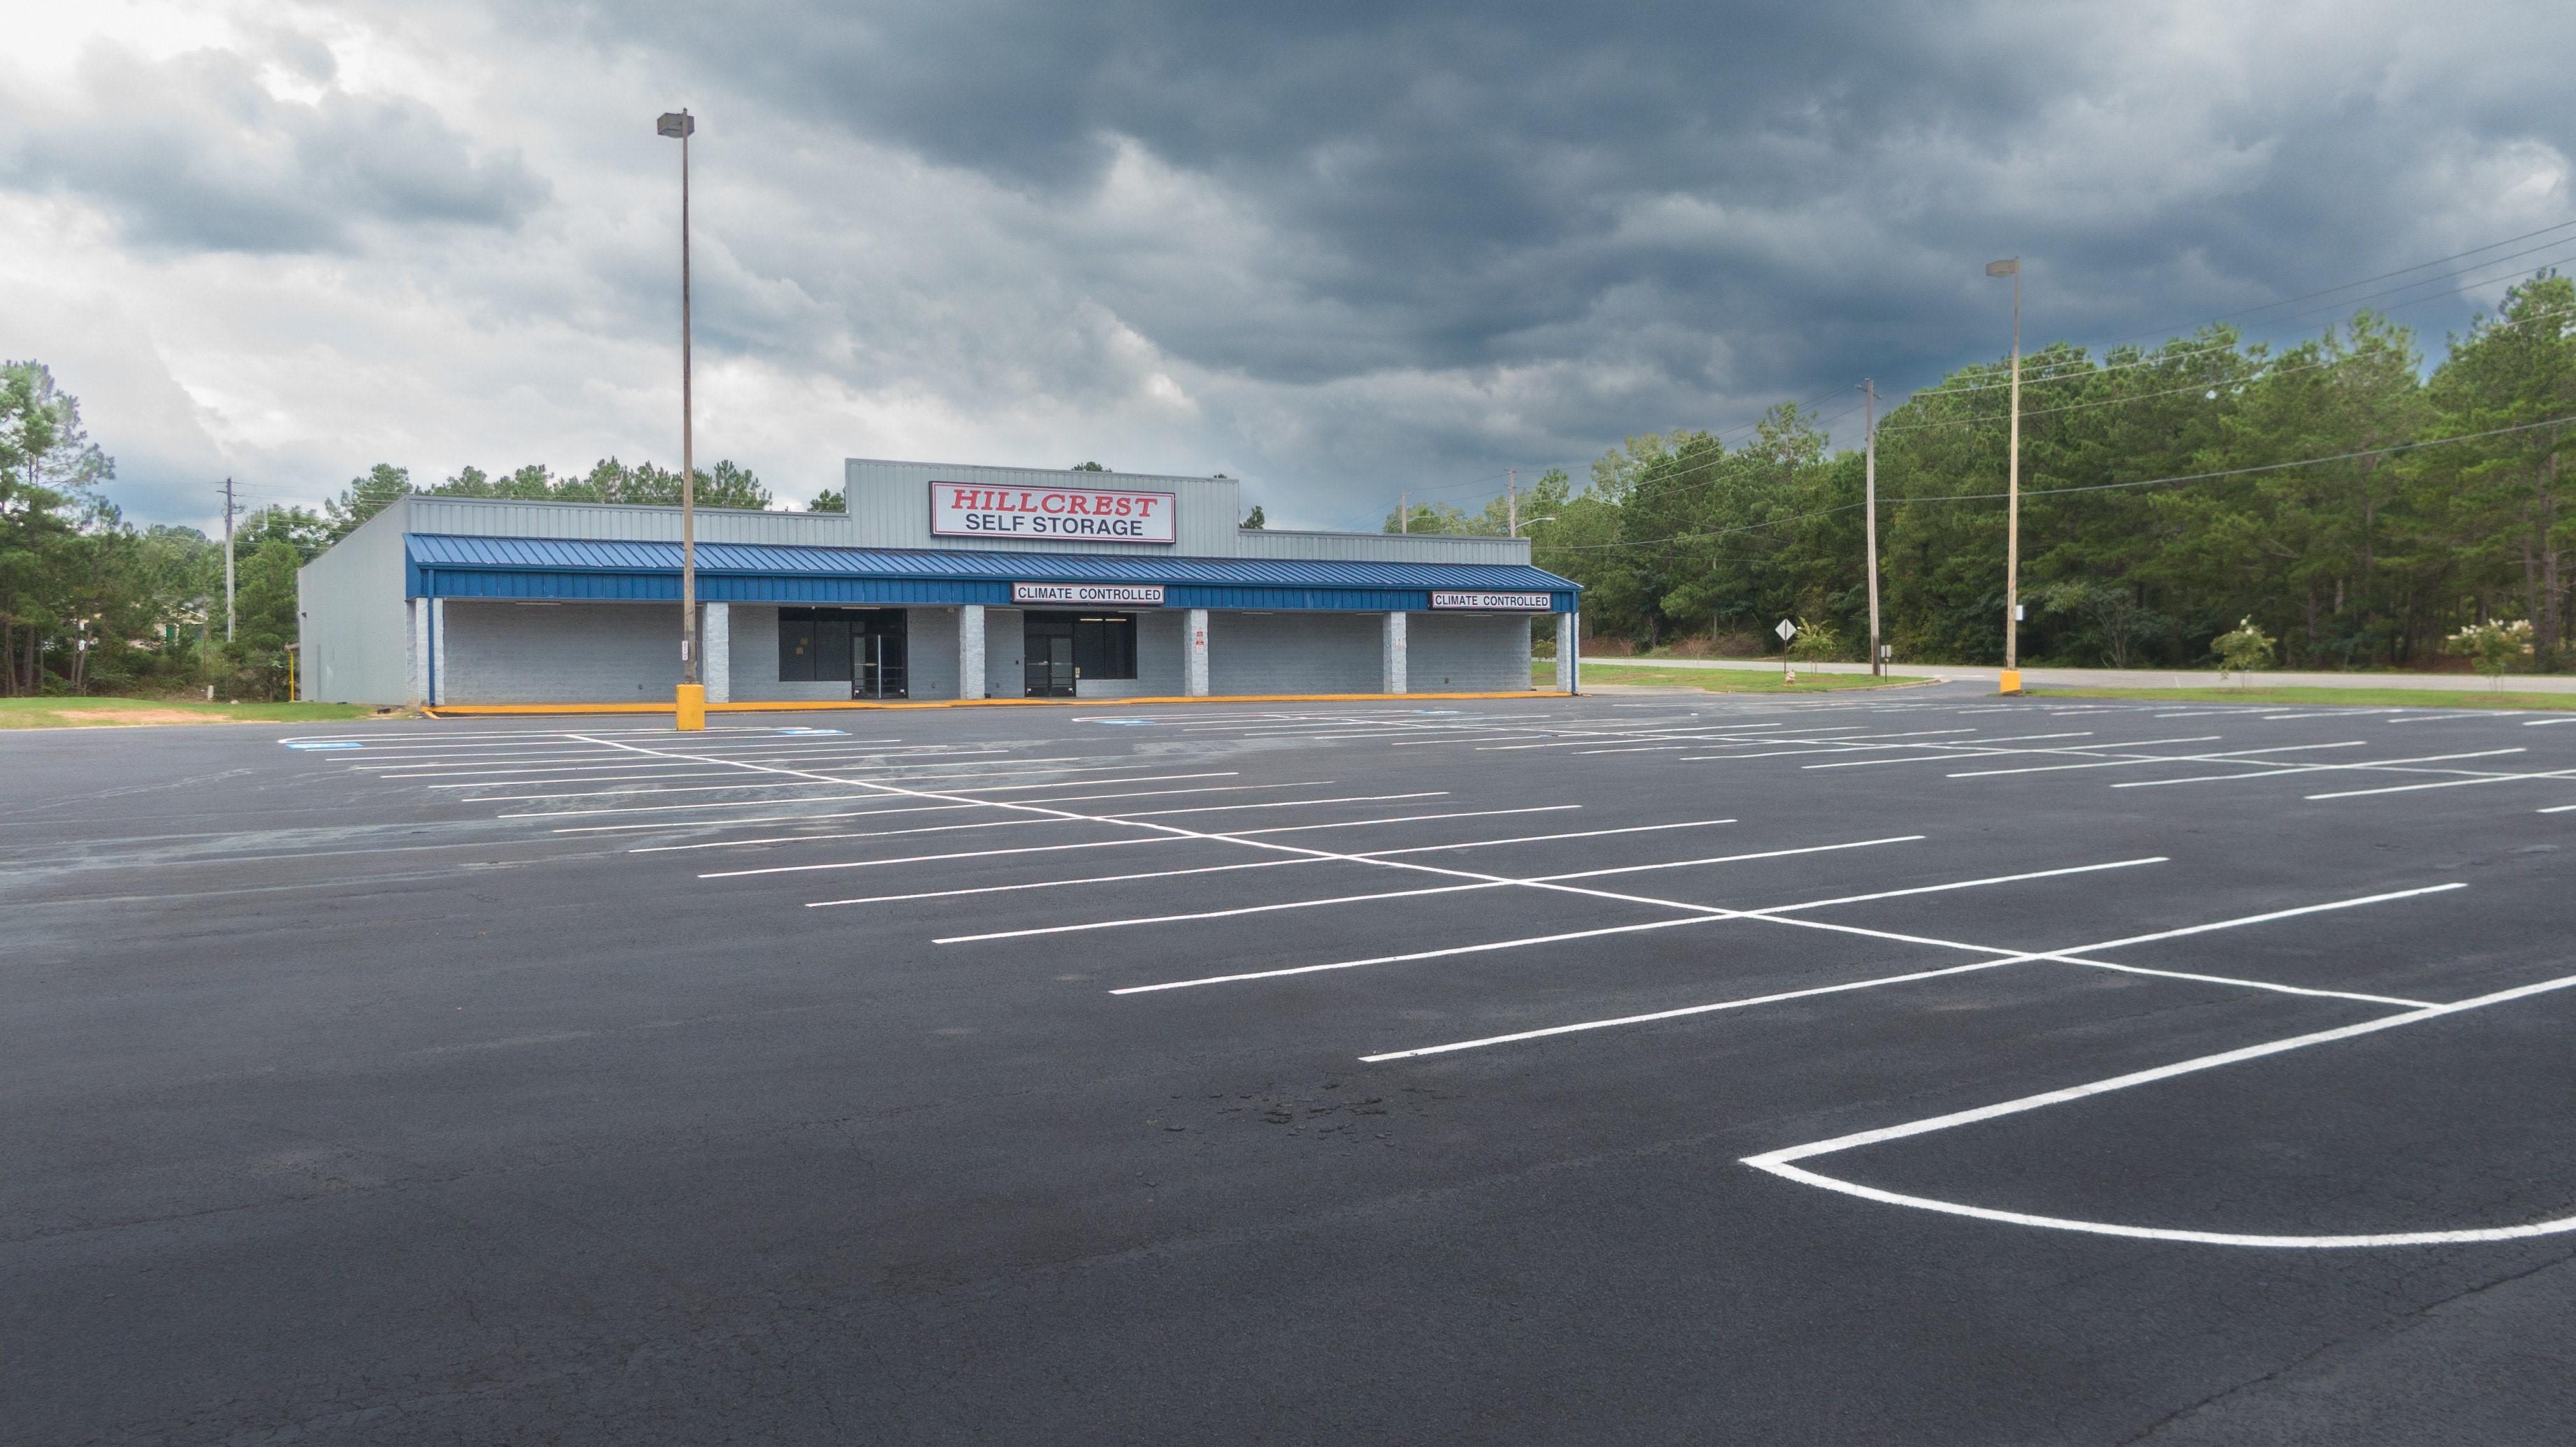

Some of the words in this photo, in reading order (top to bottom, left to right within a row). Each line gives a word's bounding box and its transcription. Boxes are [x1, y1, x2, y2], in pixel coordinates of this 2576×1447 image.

[952, 489, 1158, 517] HILLCREST
[966, 514, 1026, 532] SELF
[1033, 517, 1144, 536] STORAGE
[1018, 587, 1072, 599] CLIMATE
[1079, 588, 1160, 600] CONTROLLED
[1436, 595, 1478, 606] CLIMATE
[1484, 596, 1548, 606] CONTROLLED
